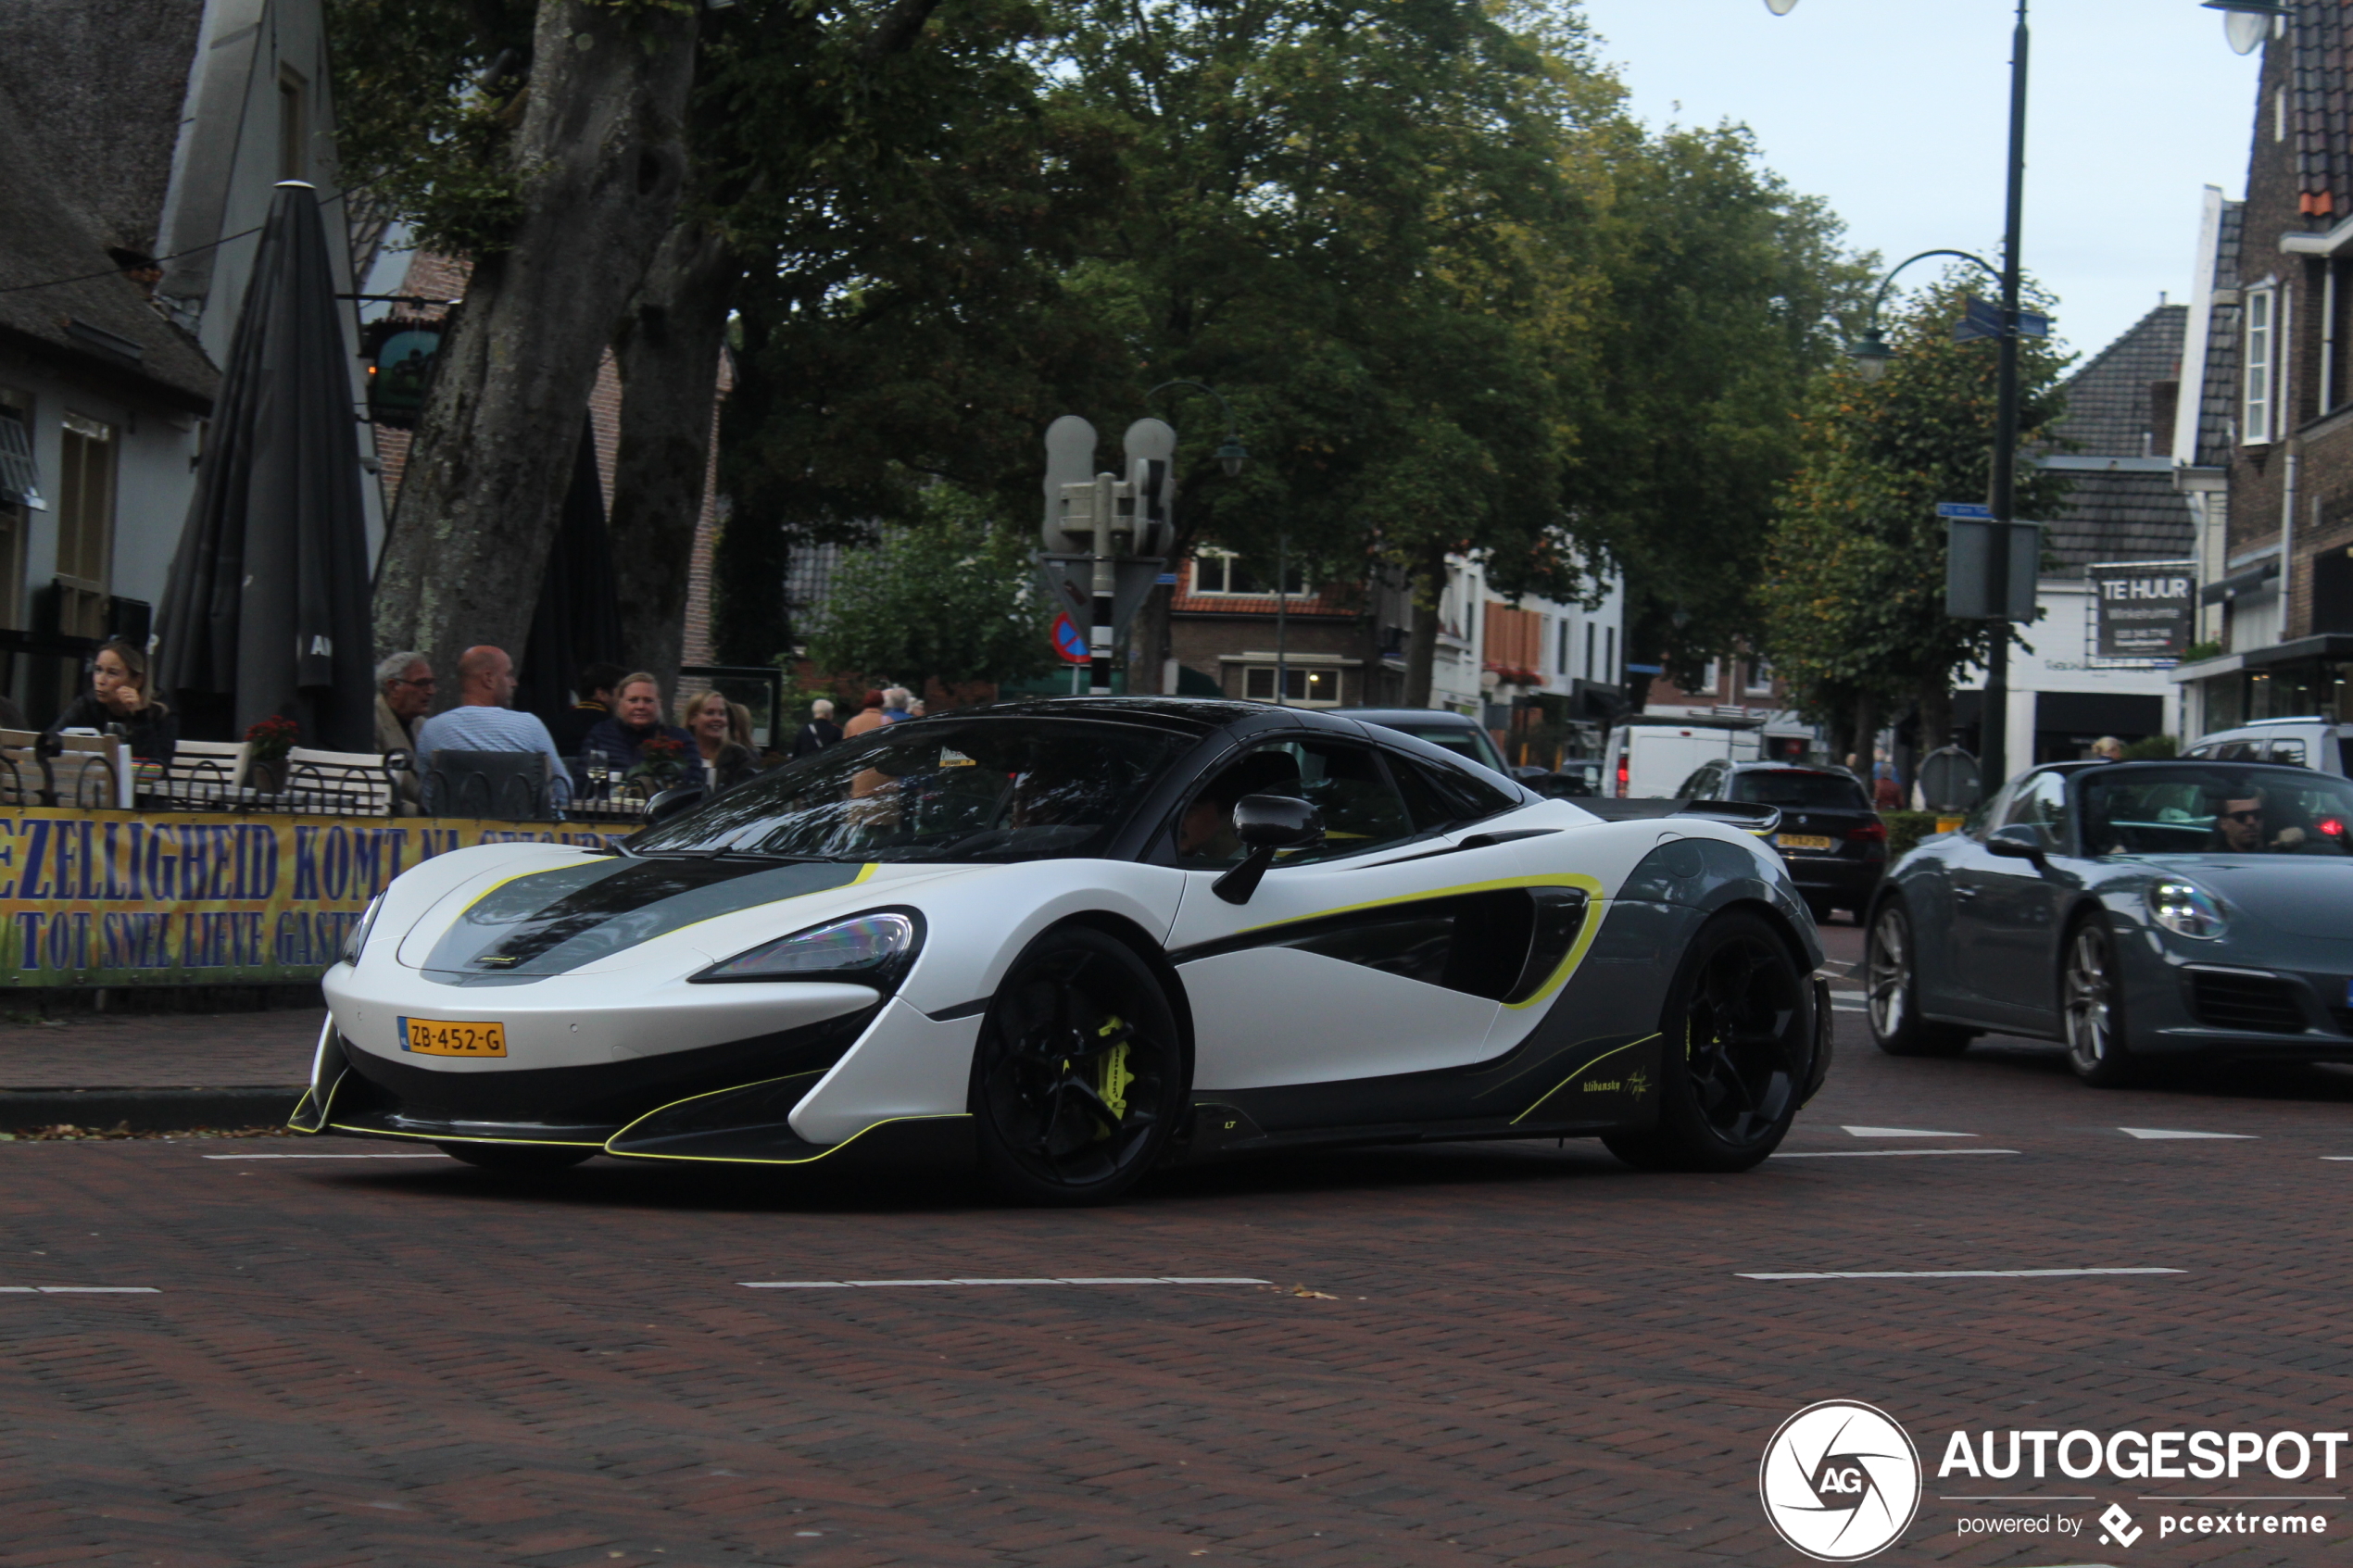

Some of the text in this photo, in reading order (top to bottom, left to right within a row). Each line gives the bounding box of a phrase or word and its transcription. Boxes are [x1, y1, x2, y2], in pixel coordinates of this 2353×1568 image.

[2101, 577, 2187, 600] TE HUUR
[292, 825, 409, 901] KOMT
[15, 911, 91, 970] TOT
[102, 911, 171, 969] SNEL
[182, 911, 265, 968] LIEVE
[411, 1025, 499, 1050] ZB-452-G
